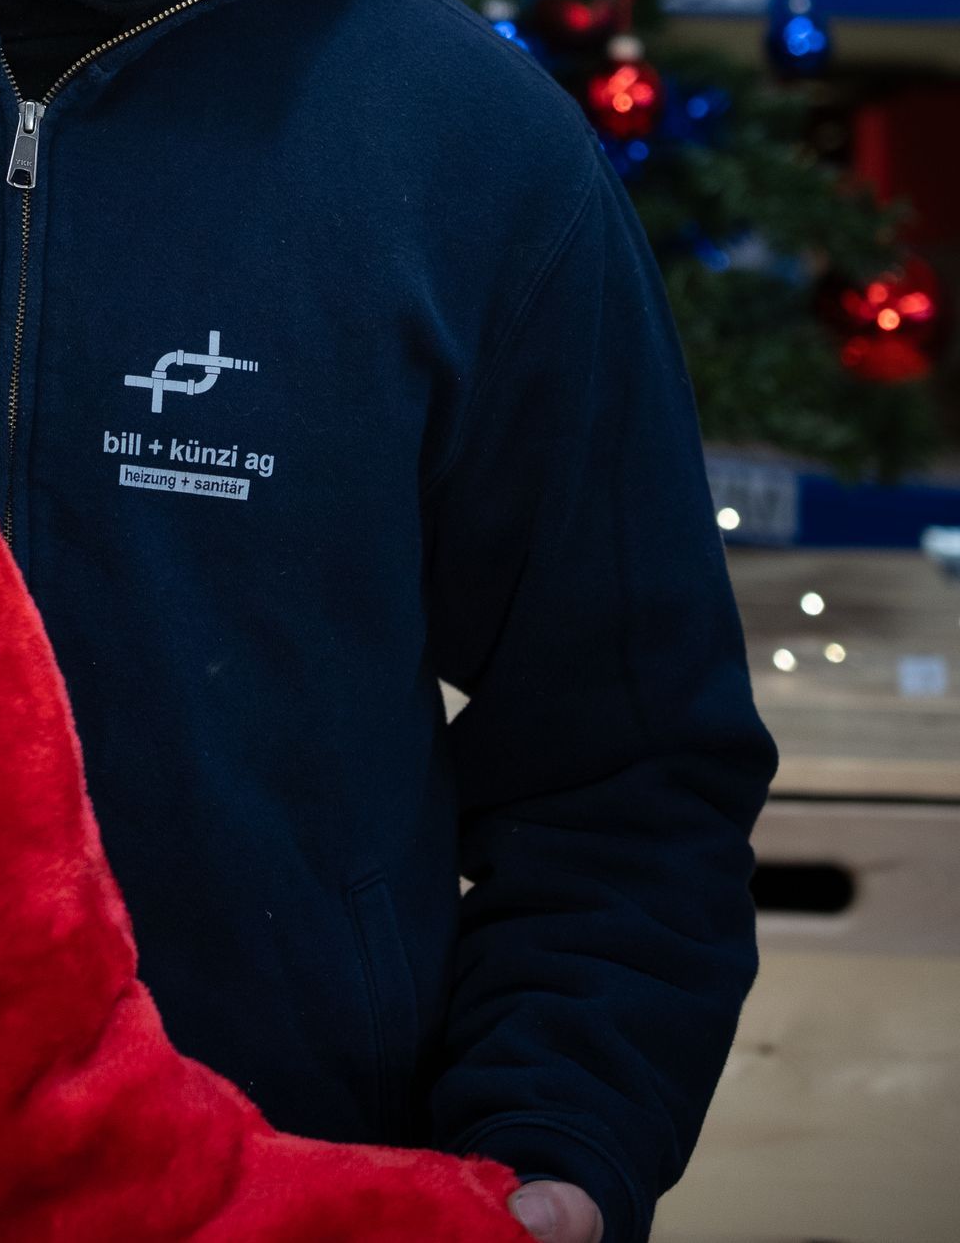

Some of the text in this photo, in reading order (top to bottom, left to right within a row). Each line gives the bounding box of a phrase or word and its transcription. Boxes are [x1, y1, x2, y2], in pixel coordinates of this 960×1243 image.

[103, 430, 275, 477] bill + künzi ag
[124, 467, 244, 495] heizung + sanitär
